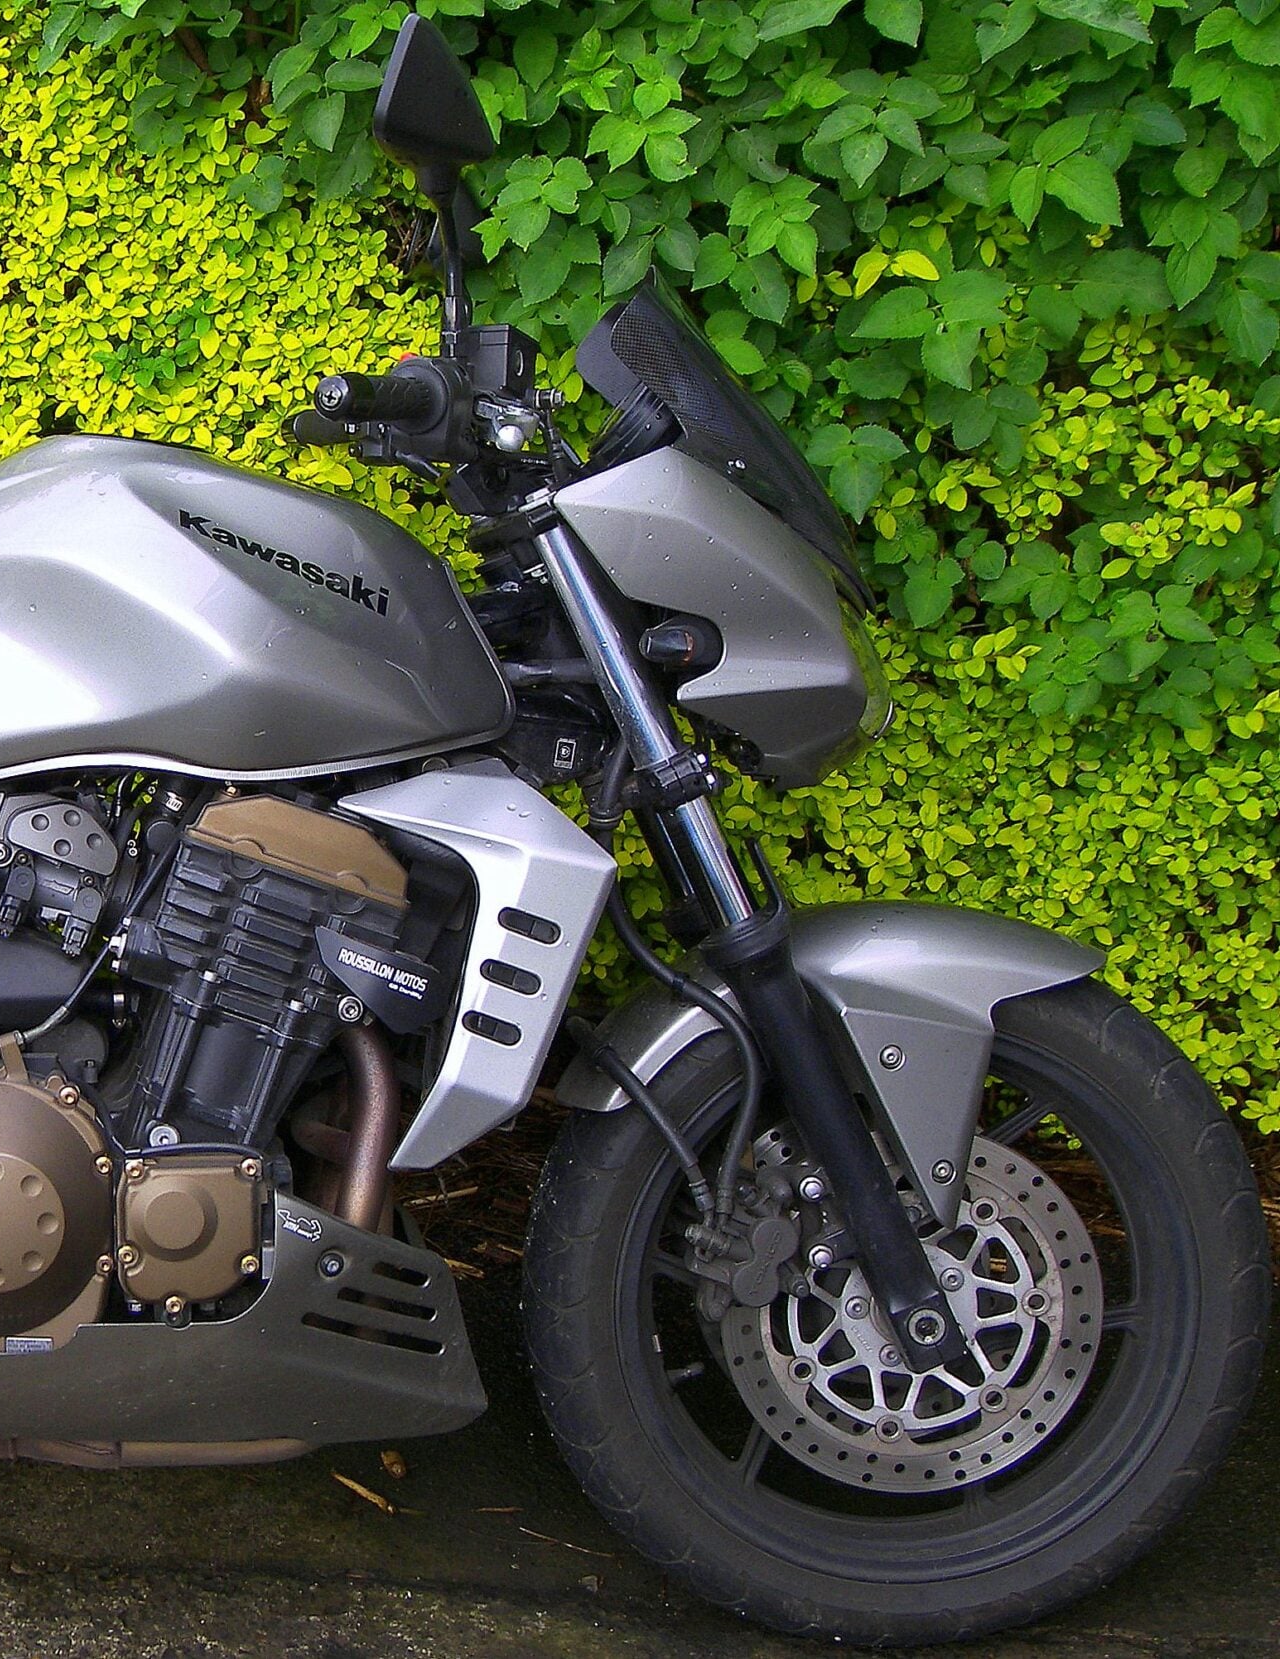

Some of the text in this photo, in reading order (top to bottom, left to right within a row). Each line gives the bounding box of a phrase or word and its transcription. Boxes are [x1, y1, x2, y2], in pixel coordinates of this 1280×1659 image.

[178, 509, 391, 617] Kawasaki
[338, 947, 428, 991] ROUSSILLON MOTOS
